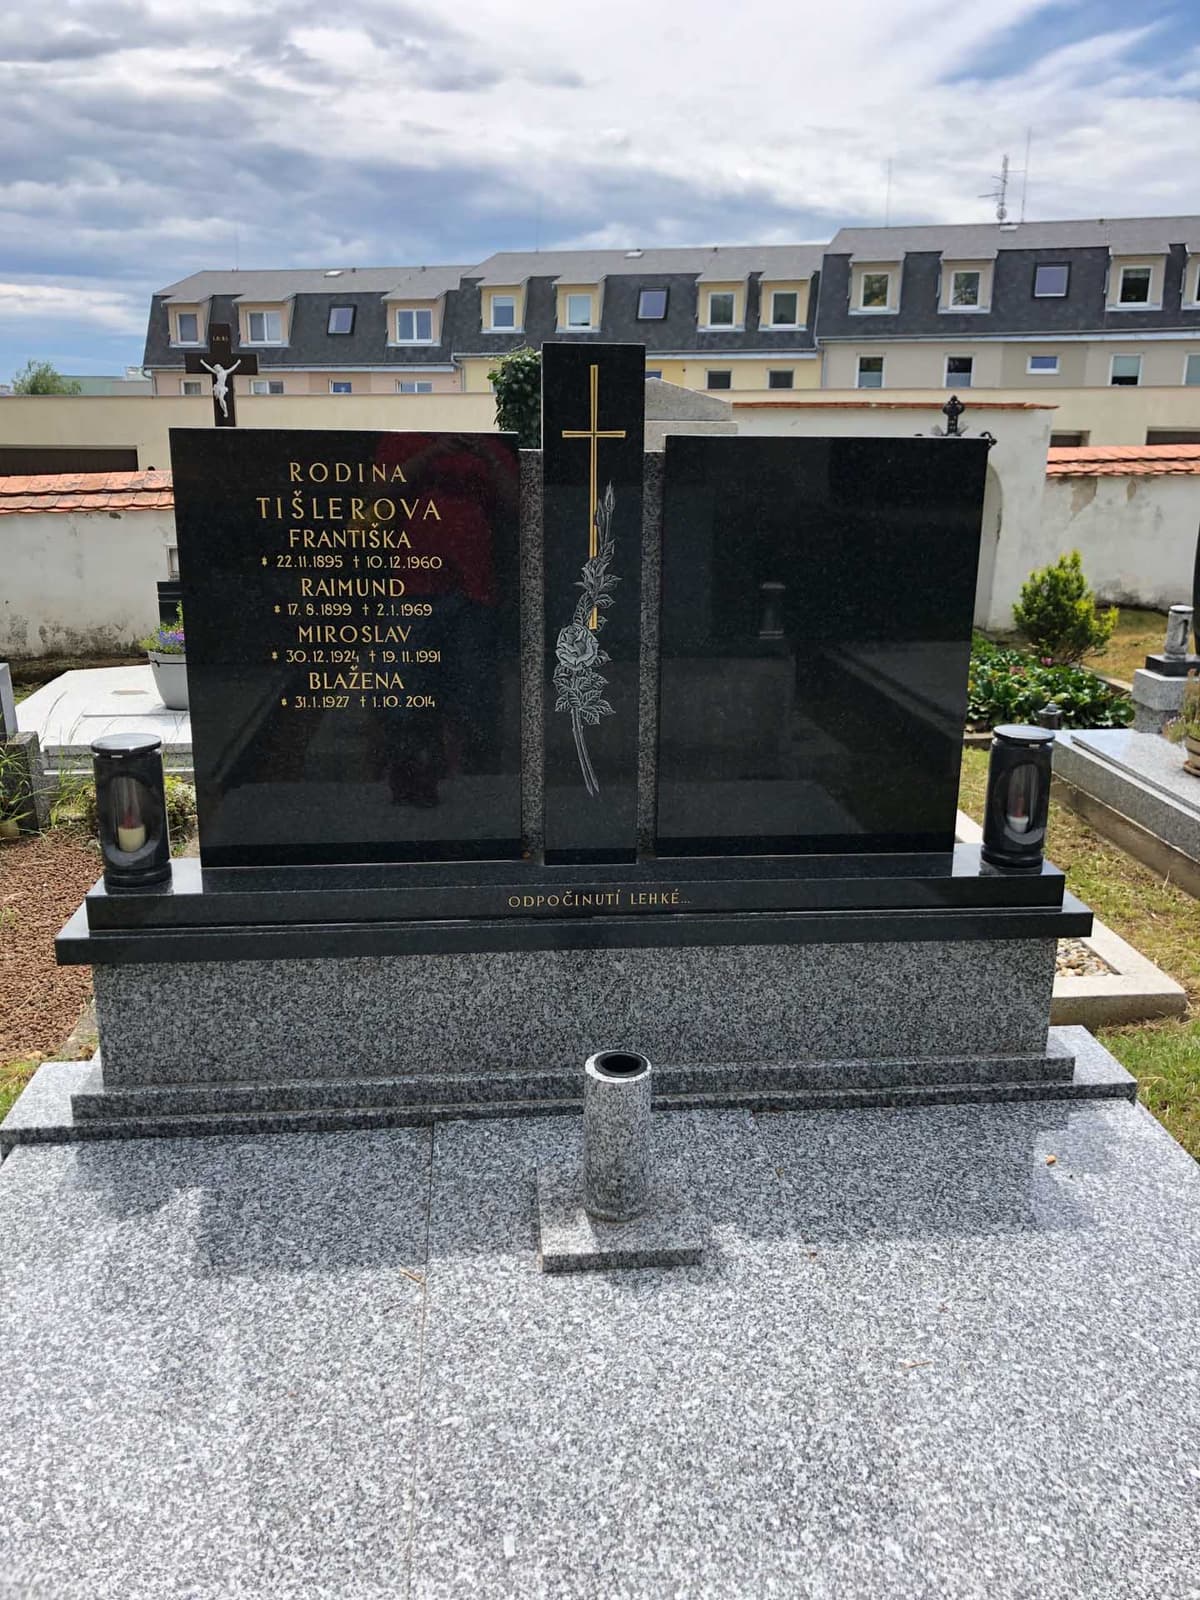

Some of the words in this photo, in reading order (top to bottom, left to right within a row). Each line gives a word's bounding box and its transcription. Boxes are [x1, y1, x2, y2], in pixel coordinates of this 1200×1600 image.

[289, 462, 407, 483] RODINA
[256, 490, 441, 520] TIŠLEROVA
[289, 522, 412, 549] FRANTIŠKA
[276, 555, 343, 568] 22.11.1895
[366, 556, 443, 569] 10.12.1960
[301, 578, 405, 597] RAIMUND
[376, 603, 433, 616] 2.1.1969
[298, 625, 412, 643] MIROSLAV
[286, 650, 360, 663] 30.12.1924
[309, 665, 405, 690] BLAŽENA
[294, 696, 350, 708] 31.1.1927
[508, 889, 621, 908] ODPOČINUTÍ
